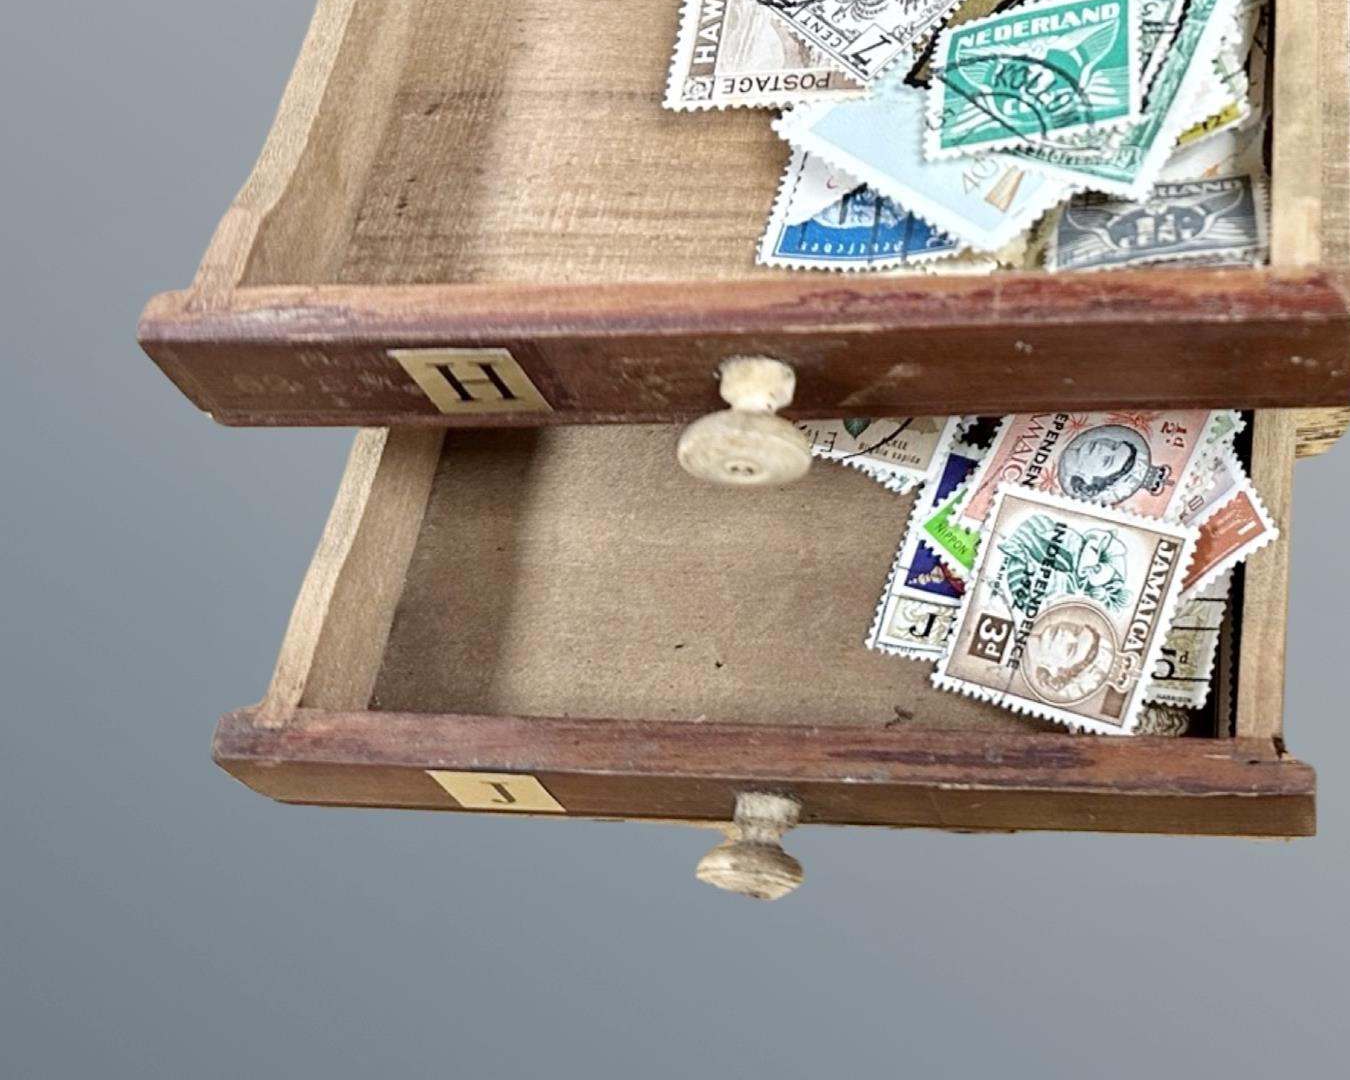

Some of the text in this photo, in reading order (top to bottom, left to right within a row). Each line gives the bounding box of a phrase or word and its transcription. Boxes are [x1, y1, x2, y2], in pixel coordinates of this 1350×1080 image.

[794, 14, 843, 48] CENT
[958, 1, 1121, 48] NEDERLAND
[722, 72, 832, 95] POSTAGE
[427, 361, 518, 403] H
[936, 521, 969, 556] NIPPON
[1006, 522, 1067, 670] INDEPENDENCE
[1013, 568, 1034, 610] 1962
[1123, 539, 1177, 656] JAMAICA
[483, 780, 515, 805] J
